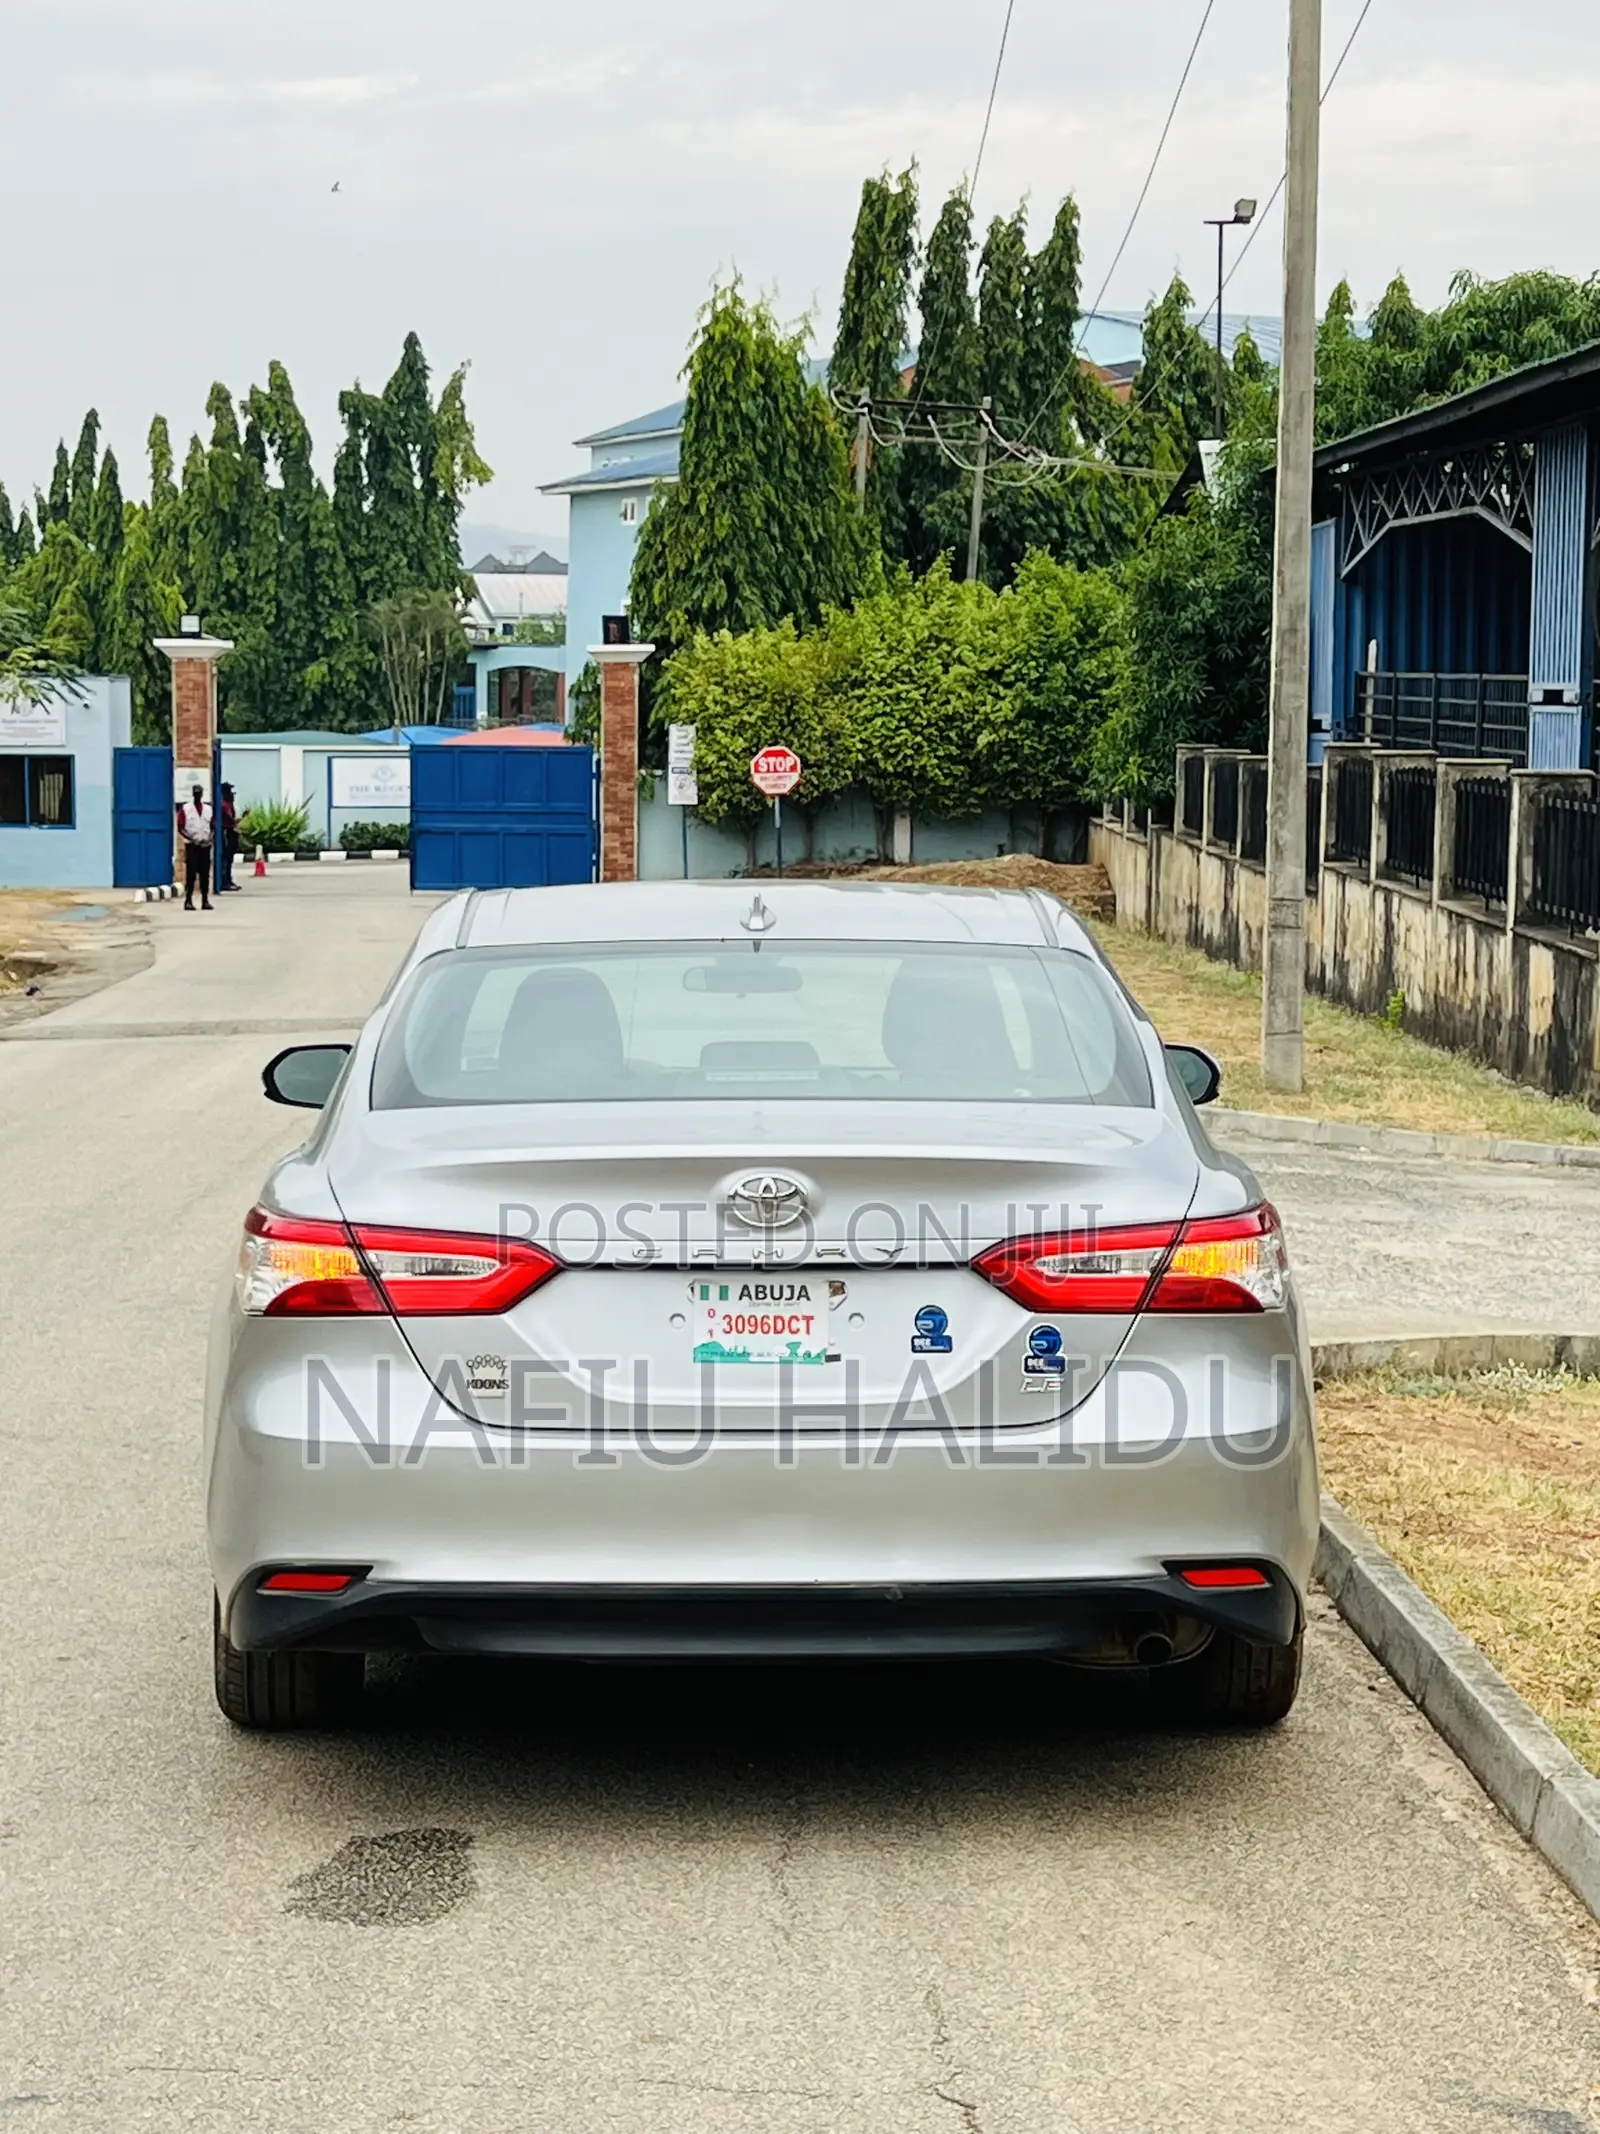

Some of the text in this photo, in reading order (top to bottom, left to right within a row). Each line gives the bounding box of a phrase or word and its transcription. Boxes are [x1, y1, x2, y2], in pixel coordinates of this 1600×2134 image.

[758, 756, 795, 772] STOP
[738, 1284, 811, 1301] ABUJA
[722, 1314, 815, 1335] 3096DCT
[467, 1379, 510, 1390] KOONS
[1020, 1378, 1065, 1393] LE
